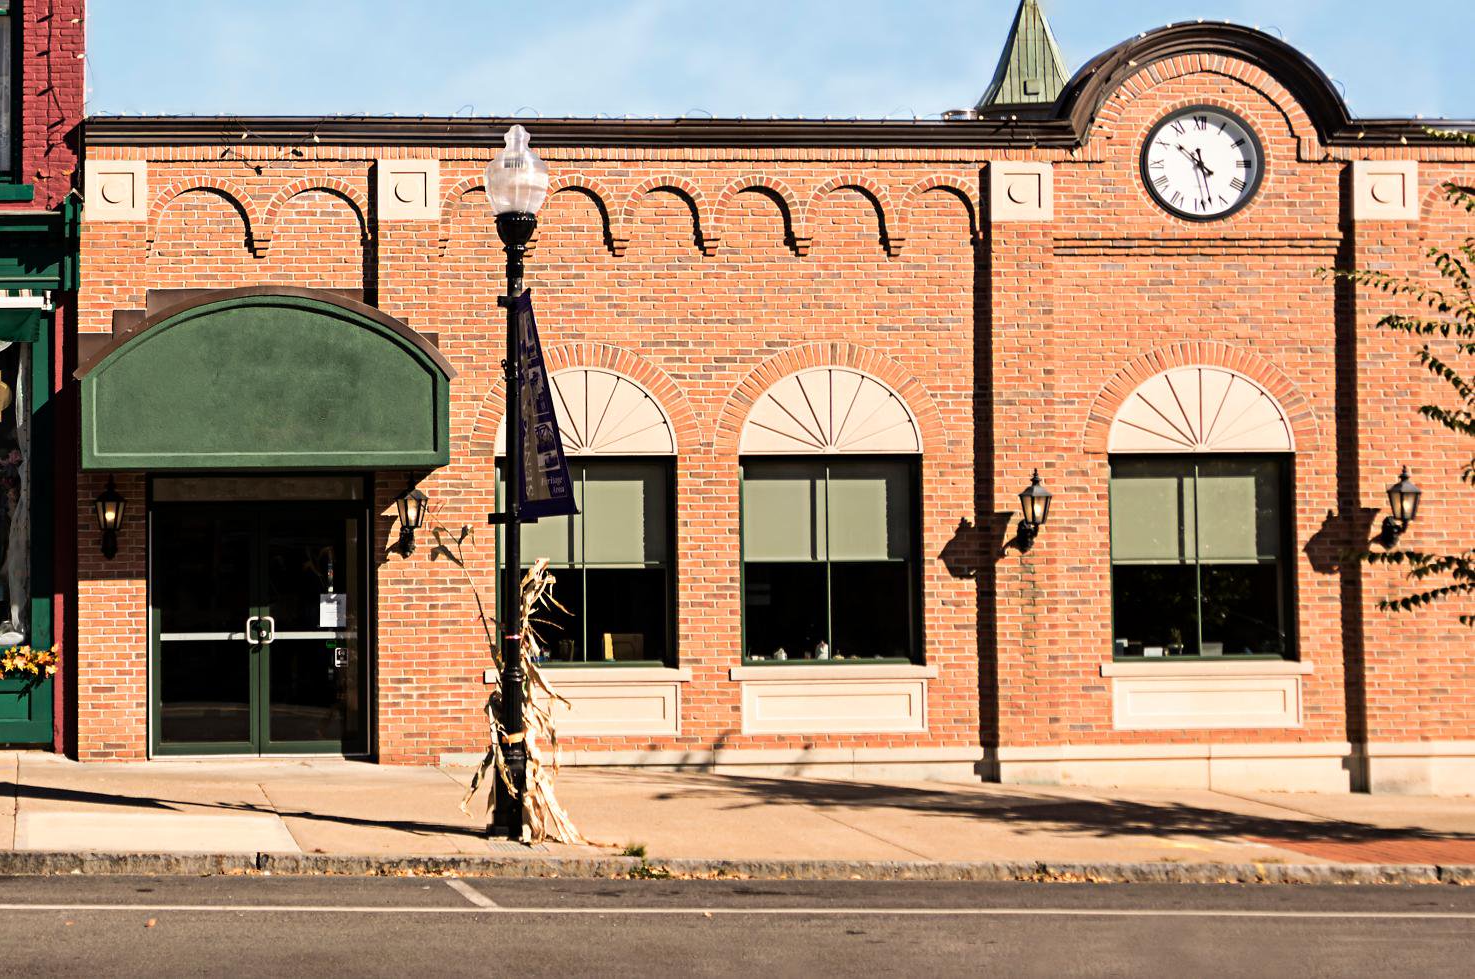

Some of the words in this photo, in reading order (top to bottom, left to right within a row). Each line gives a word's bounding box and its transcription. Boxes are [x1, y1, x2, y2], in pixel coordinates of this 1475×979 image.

[1171, 119, 1186, 136] XI
[1193, 116, 1207, 131] XII
[1155, 137, 1170, 151] X
[1236, 160, 1252, 168] III
